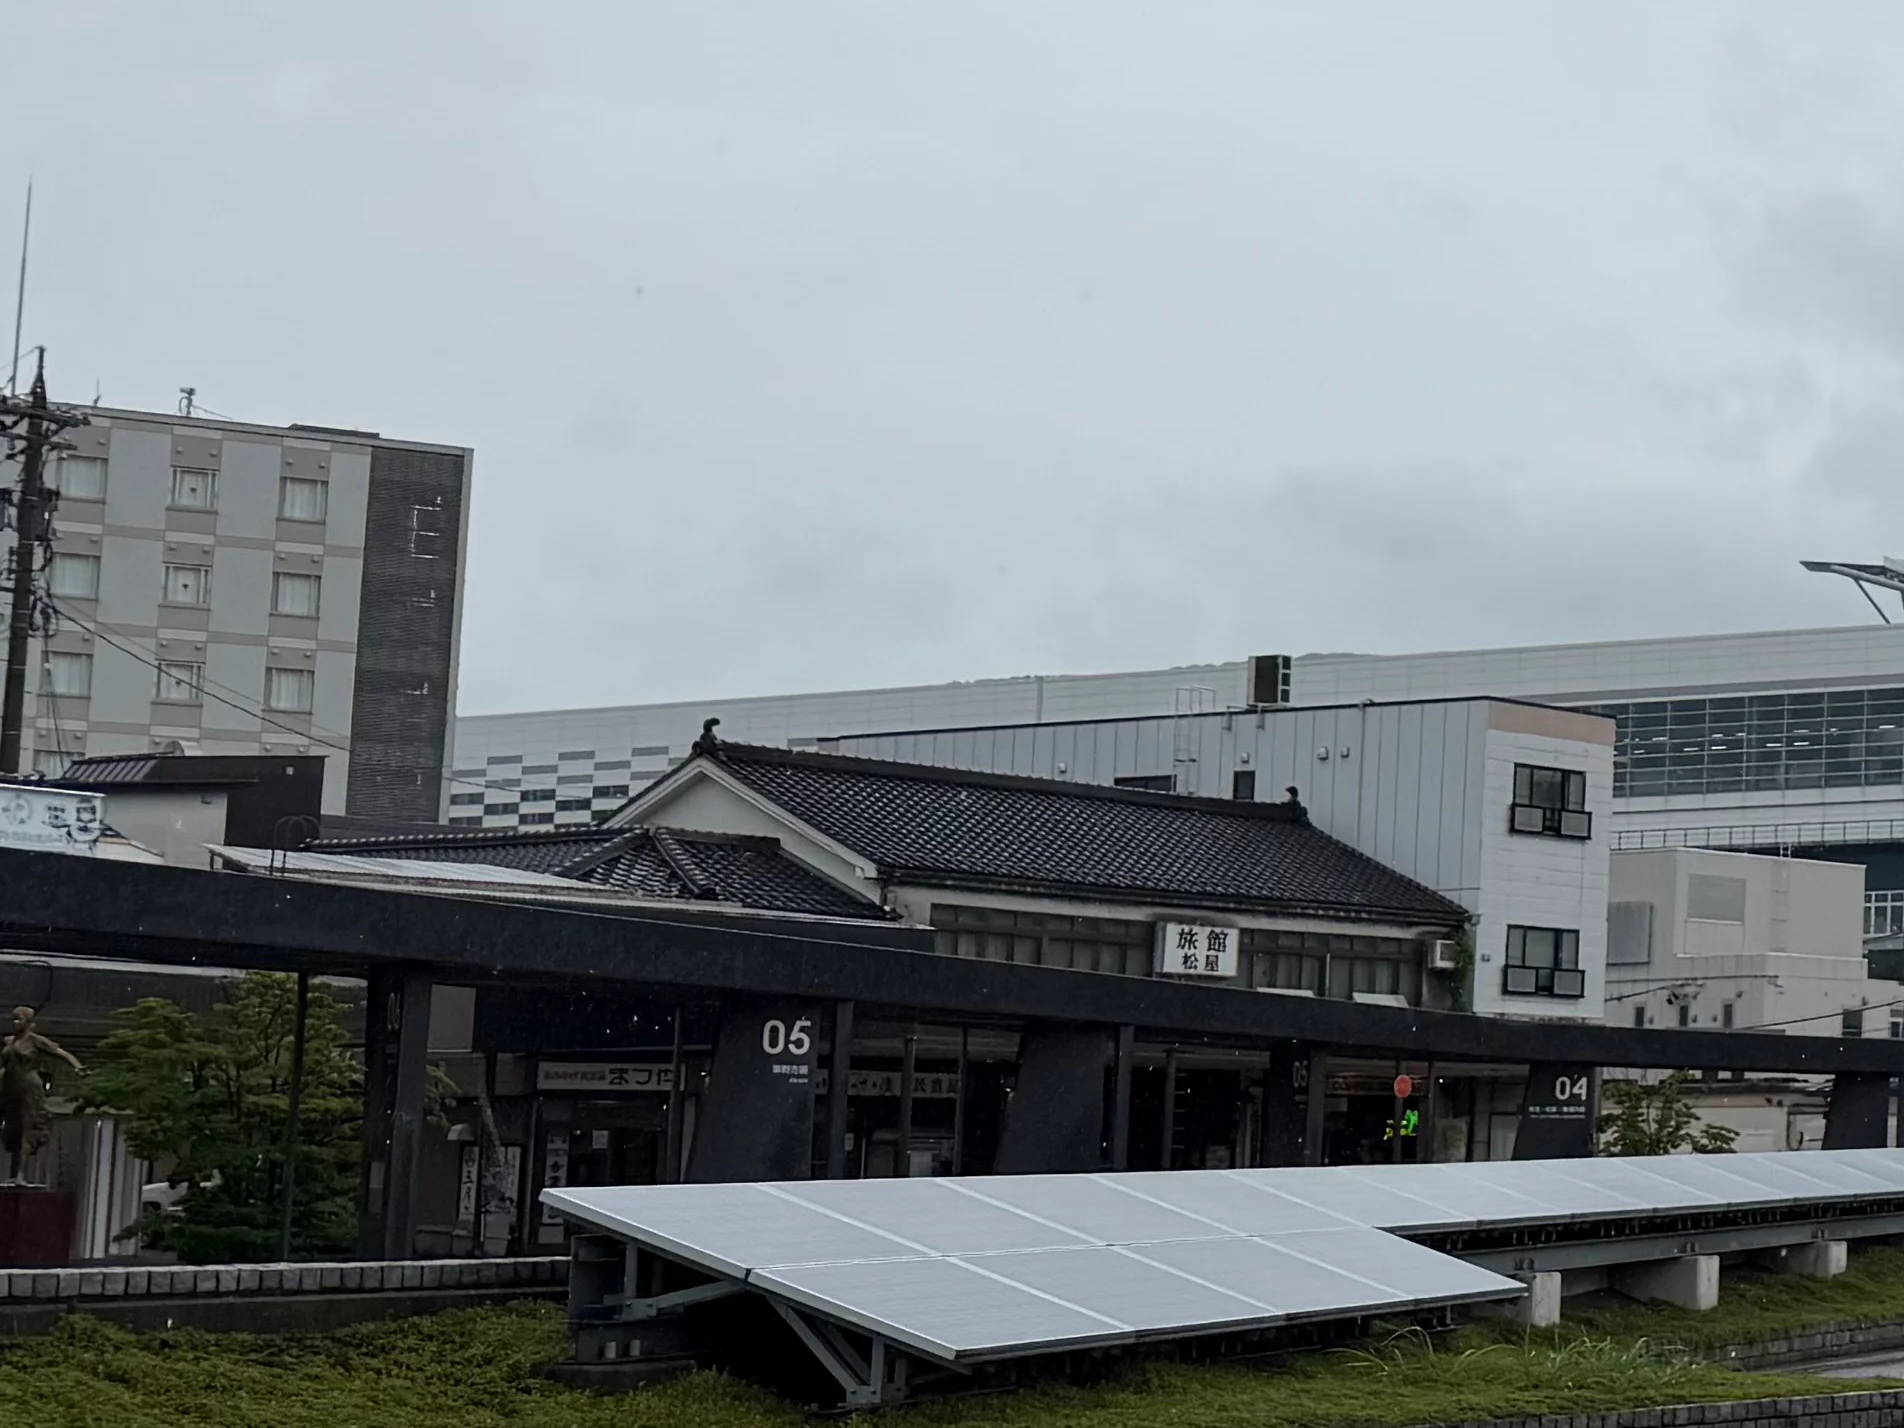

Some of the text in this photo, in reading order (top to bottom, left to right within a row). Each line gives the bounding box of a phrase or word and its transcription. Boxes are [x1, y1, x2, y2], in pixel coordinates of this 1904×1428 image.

[1176, 927, 1229, 953] 旅館
[762, 1020, 812, 1055] 05
[1555, 1076, 1588, 1100] 04
